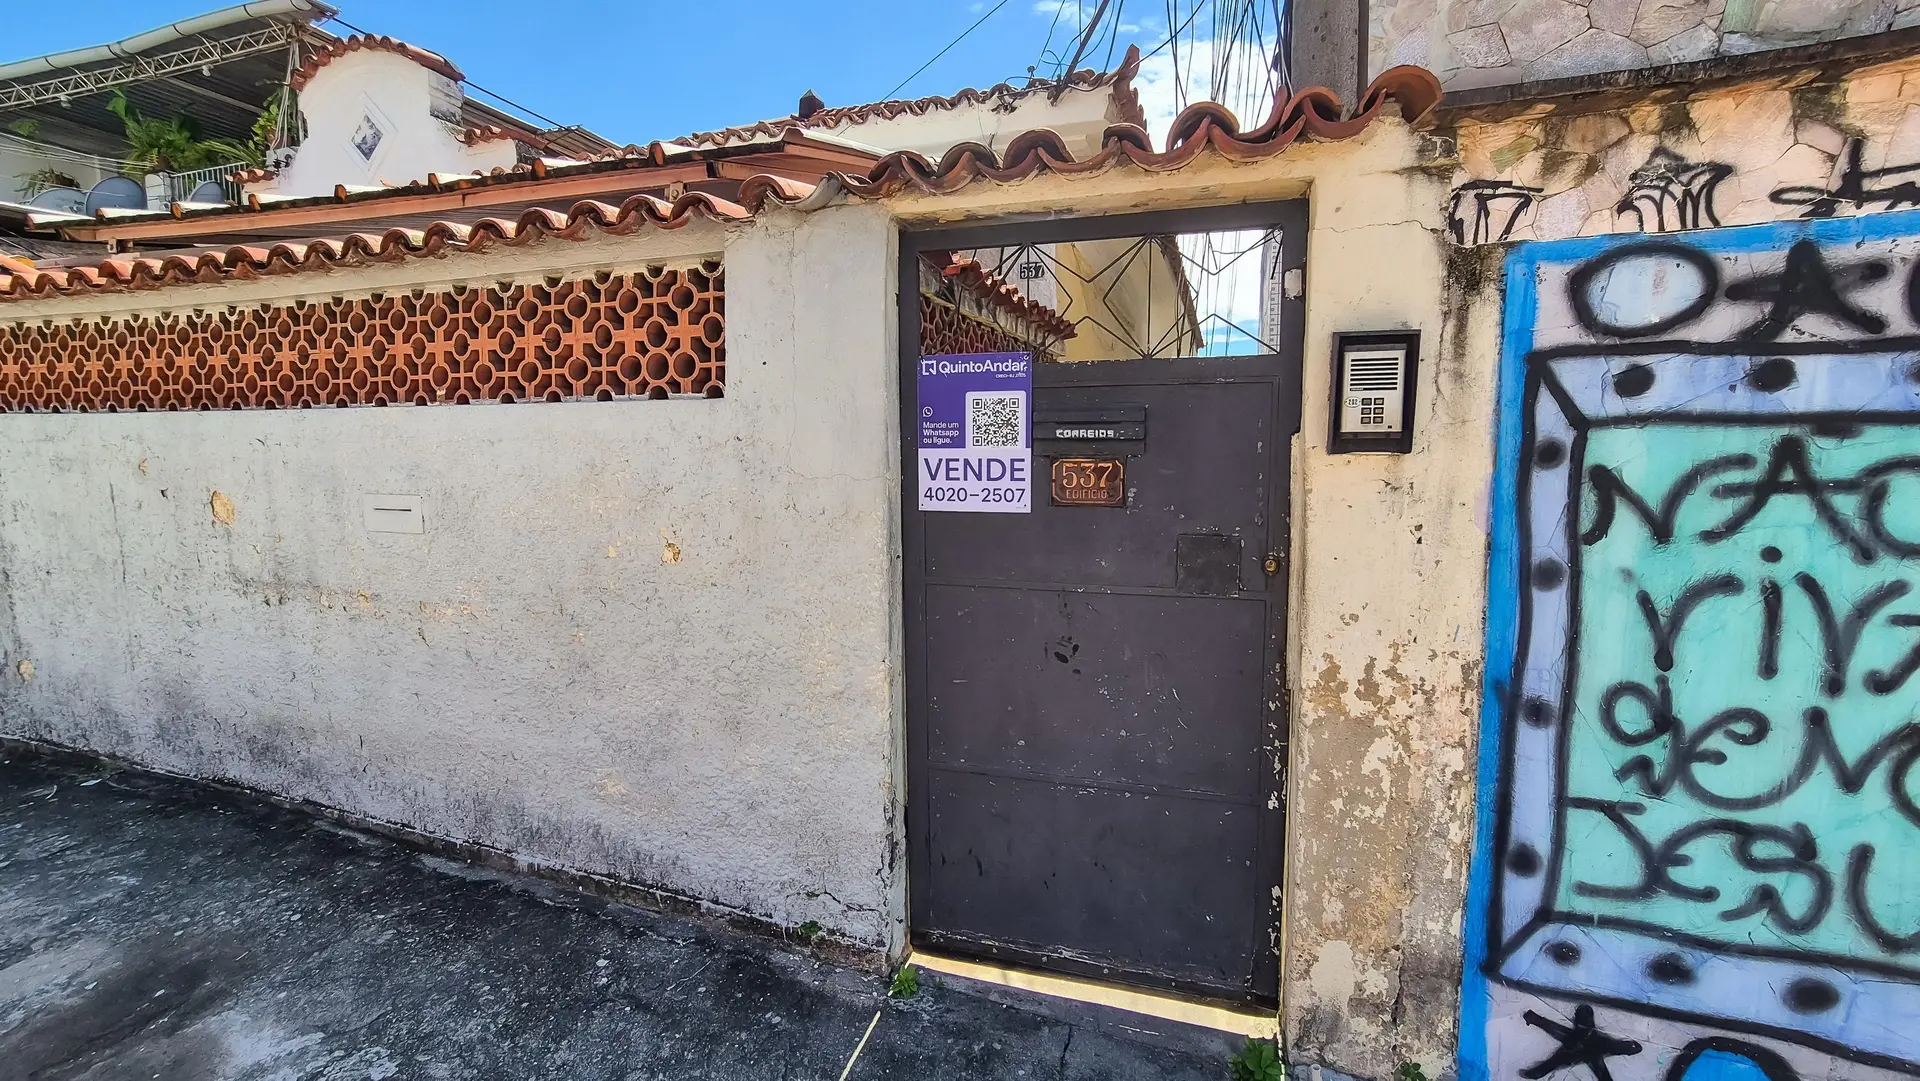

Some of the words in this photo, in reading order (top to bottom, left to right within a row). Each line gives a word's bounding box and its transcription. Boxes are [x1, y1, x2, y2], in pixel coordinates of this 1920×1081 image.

[1021, 263, 1045, 279] 537
[938, 359, 1027, 374] QuintoAndar
[922, 421, 947, 429] Mande
[923, 429, 960, 438] Whatsapp
[1055, 429, 1115, 439] CORREIOS
[933, 437, 953, 446] ligue.
[923, 458, 1027, 482] VENDE
[1062, 462, 1113, 488] 537
[923, 487, 1026, 503] 4020-2507
